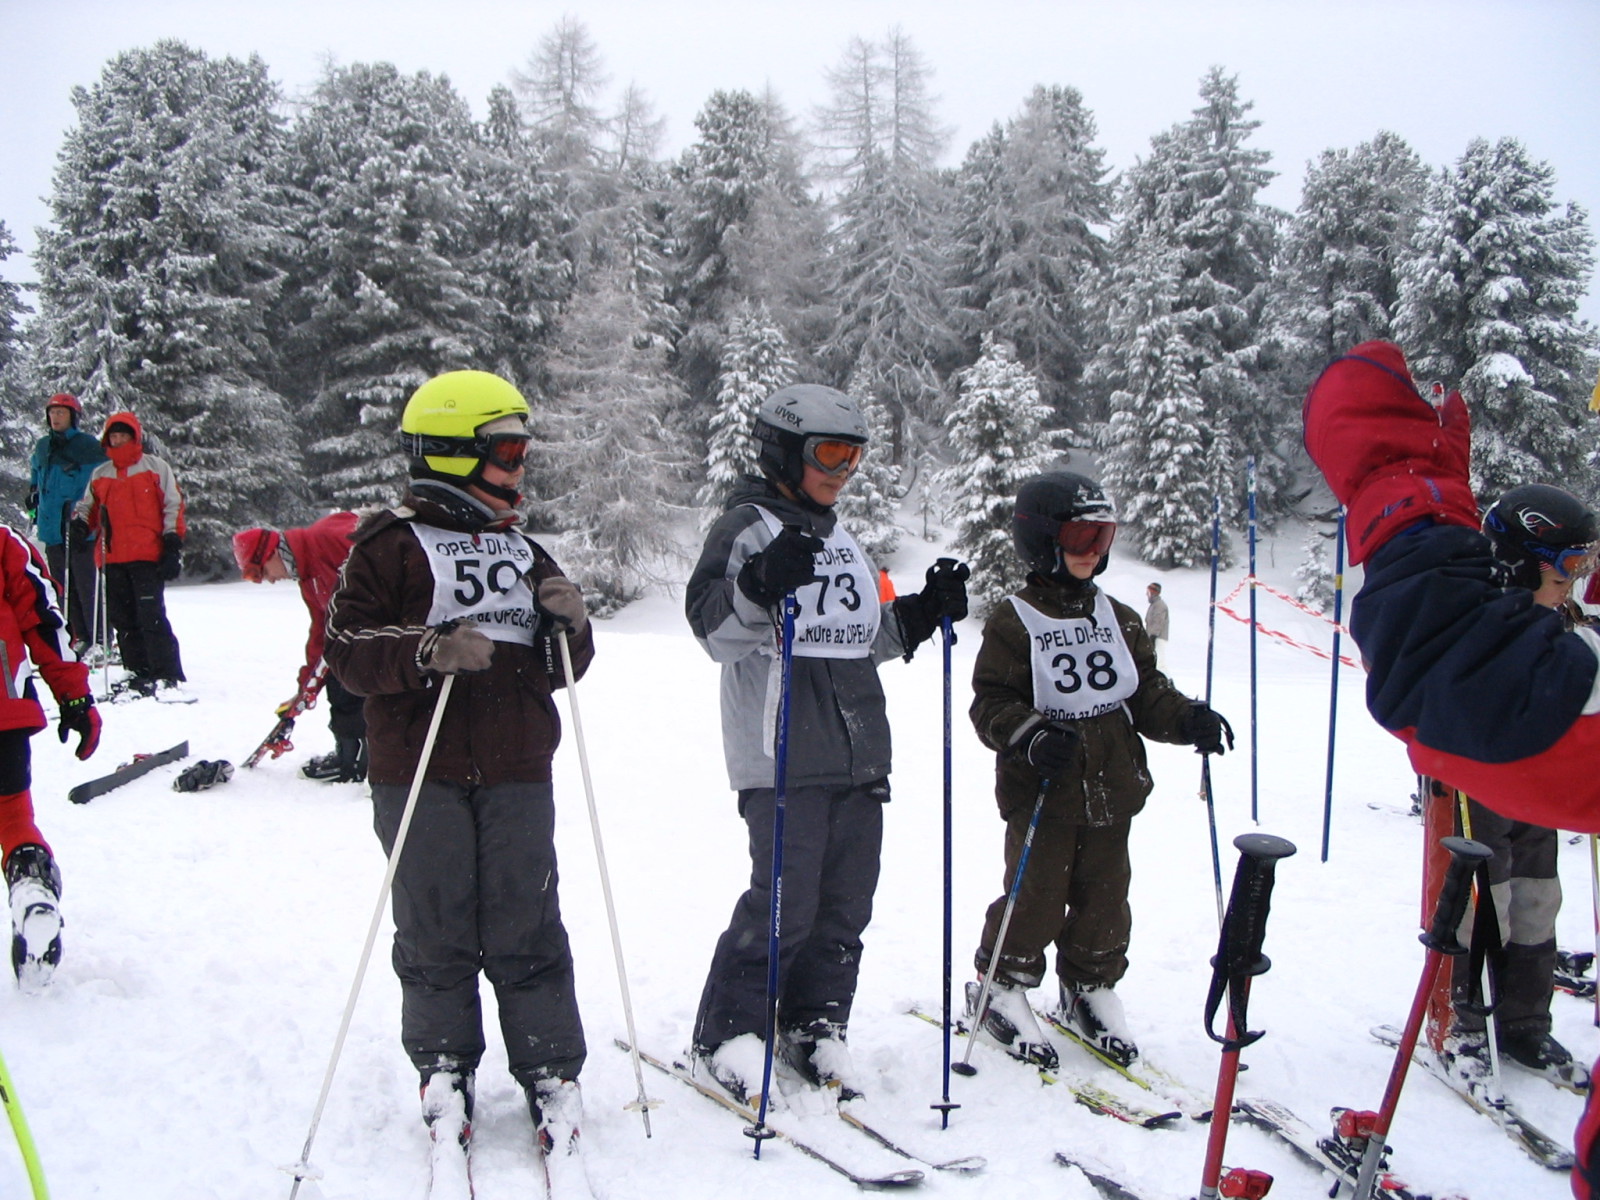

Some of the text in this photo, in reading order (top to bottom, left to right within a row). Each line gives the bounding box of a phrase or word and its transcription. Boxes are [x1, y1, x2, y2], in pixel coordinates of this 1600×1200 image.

[774, 405, 803, 428] uvex
[436, 540, 484, 556] OPEL
[813, 572, 861, 616] 73
[834, 628, 845, 644] az
[1051, 649, 1118, 694] 38
